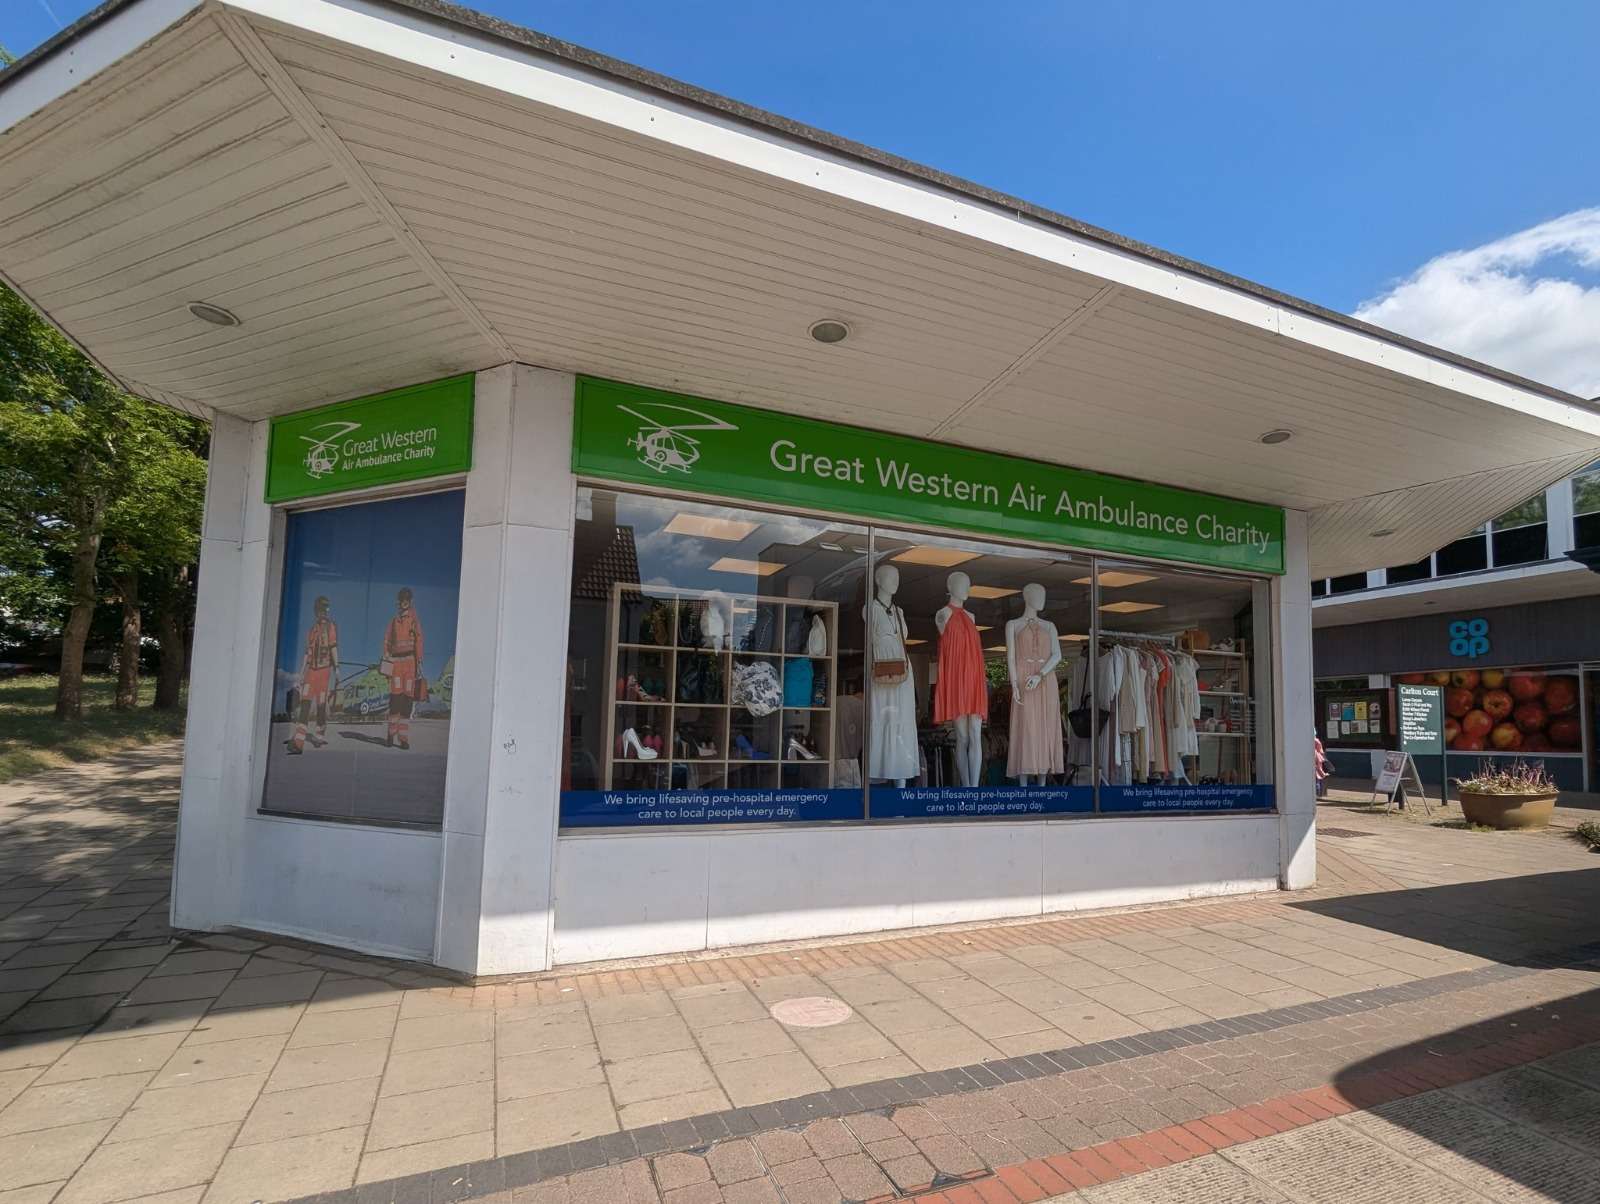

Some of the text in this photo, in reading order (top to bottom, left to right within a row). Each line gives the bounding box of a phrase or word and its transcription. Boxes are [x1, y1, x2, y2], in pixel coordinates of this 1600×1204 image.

[343, 427, 437, 457] Great Western
[342, 446, 435, 471] Air Ambulance Charity
[769, 439, 1270, 554] Great Western Air Ambulance Charity
[1423, 688, 1439, 696] Court
[604, 792, 829, 807] We bring lifesaving pre-hospital emergency
[901, 789, 1069, 801] We bring lifesaving pre-hospital emergency
[1123, 787, 1253, 797] We bring lifesaving pre-hospital emergency
[638, 805, 796, 820] care to local people every day.
[926, 804, 944, 812] care
[946, 803, 955, 811] to
[957, 802, 976, 811] local
[977, 802, 1005, 812] people
[1006, 803, 1028, 811] every
